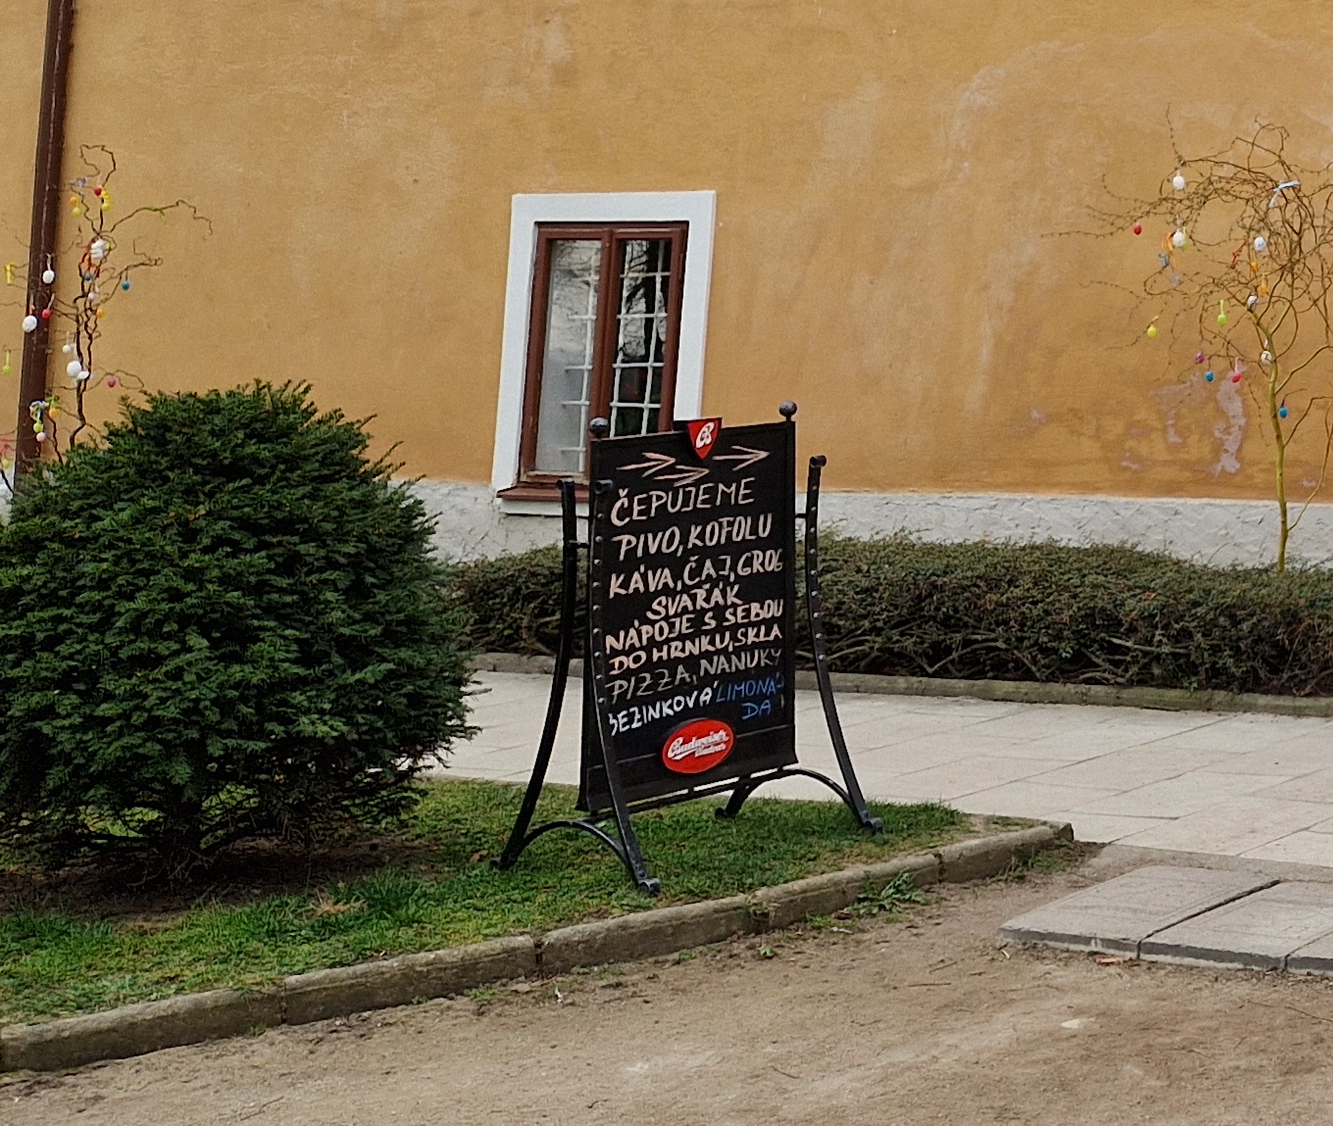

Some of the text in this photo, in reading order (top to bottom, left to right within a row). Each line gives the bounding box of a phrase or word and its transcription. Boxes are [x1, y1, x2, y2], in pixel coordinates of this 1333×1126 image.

[610, 477, 756, 527] ČEPUJEME
[646, 581, 743, 620] SVAŘÁK
[605, 598, 784, 655] NÁPOJE S SEBOU
[609, 650, 647, 675] DO
